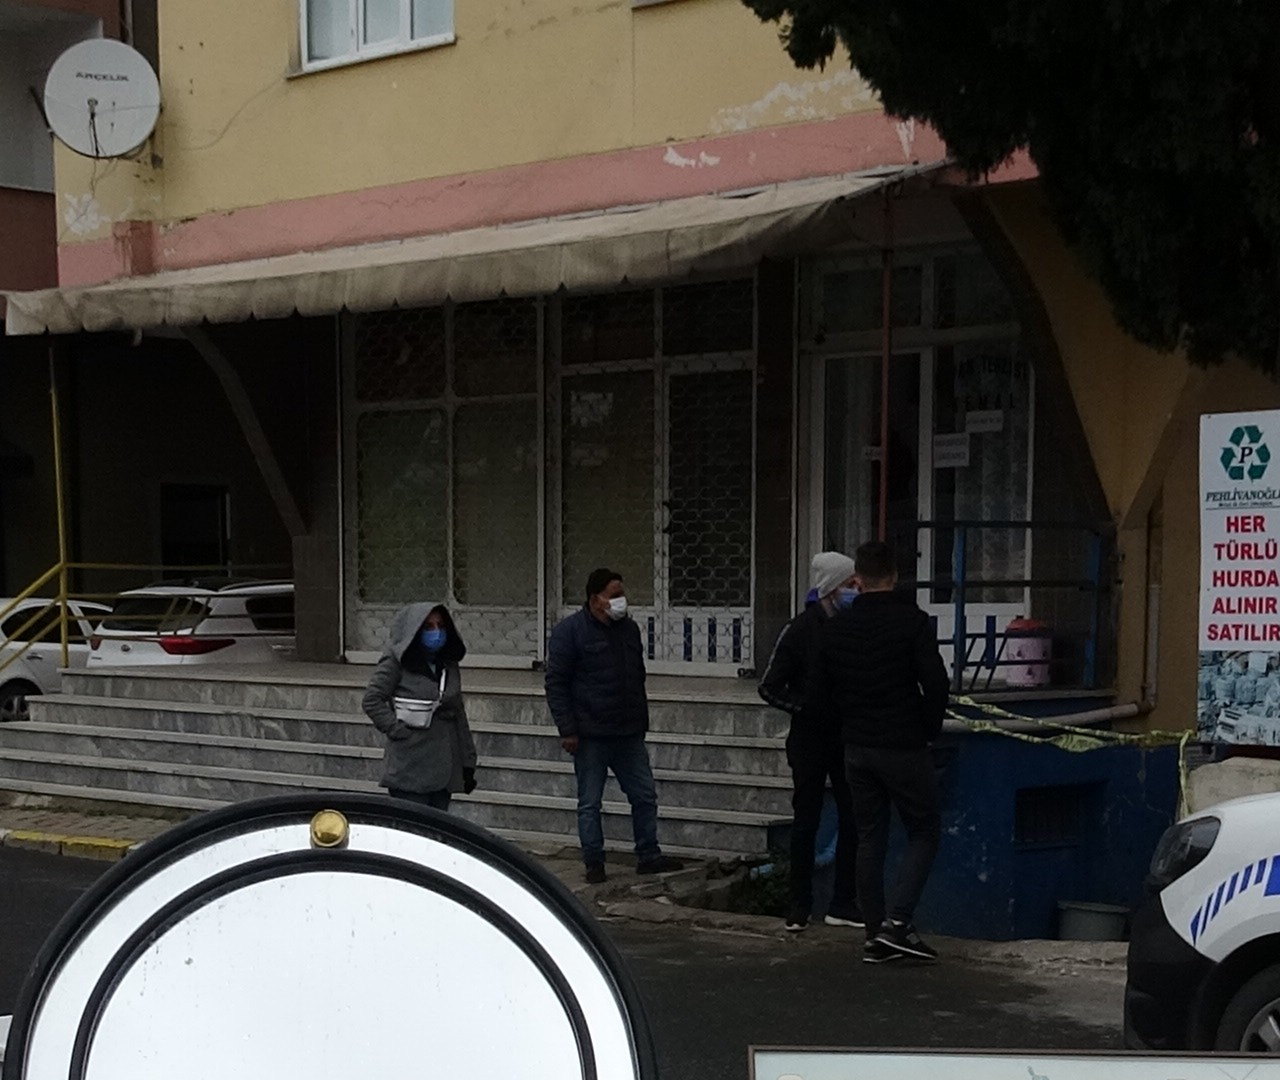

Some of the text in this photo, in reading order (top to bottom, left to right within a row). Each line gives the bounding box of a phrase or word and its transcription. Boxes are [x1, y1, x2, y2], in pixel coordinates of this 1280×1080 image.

[1225, 514, 1266, 534] HER
[1213, 538, 1279, 561] TÜRLÜ
[1212, 569, 1280, 588] HURDA
[1212, 596, 1278, 615] ALINIR
